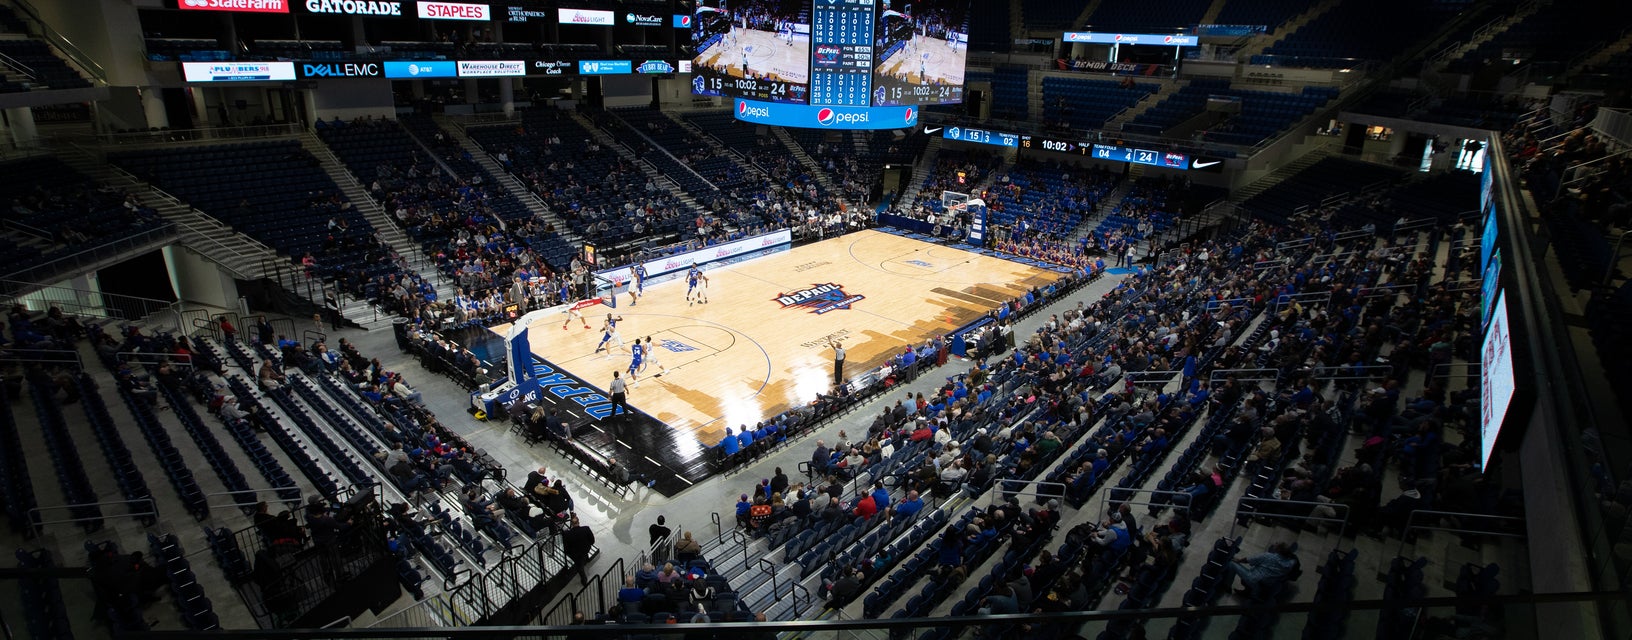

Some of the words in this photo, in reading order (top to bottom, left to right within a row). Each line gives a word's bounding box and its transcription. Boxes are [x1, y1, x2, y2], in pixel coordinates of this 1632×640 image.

[306, 0, 401, 15] GATORADE
[426, 4, 482, 18] STAPLES
[636, 14, 662, 23] NovaCare
[303, 64, 344, 77] DELL
[344, 63, 378, 76] EMC
[1074, 61, 1107, 69] DEMON
[710, 78, 722, 89] 15
[735, 80, 757, 90] 10:02
[771, 83, 785, 95] 24
[892, 87, 902, 99] 15
[913, 87, 930, 96] 10:02
[939, 87, 950, 97] 24
[747, 106, 769, 117] pepsi
[836, 112, 869, 124] pepsi
[970, 132, 979, 140] 15
[1042, 140, 1067, 151] 10:02
[1099, 150, 1110, 158] 04
[1140, 152, 1152, 162] 24
[680, 258, 694, 266] LIGHT
